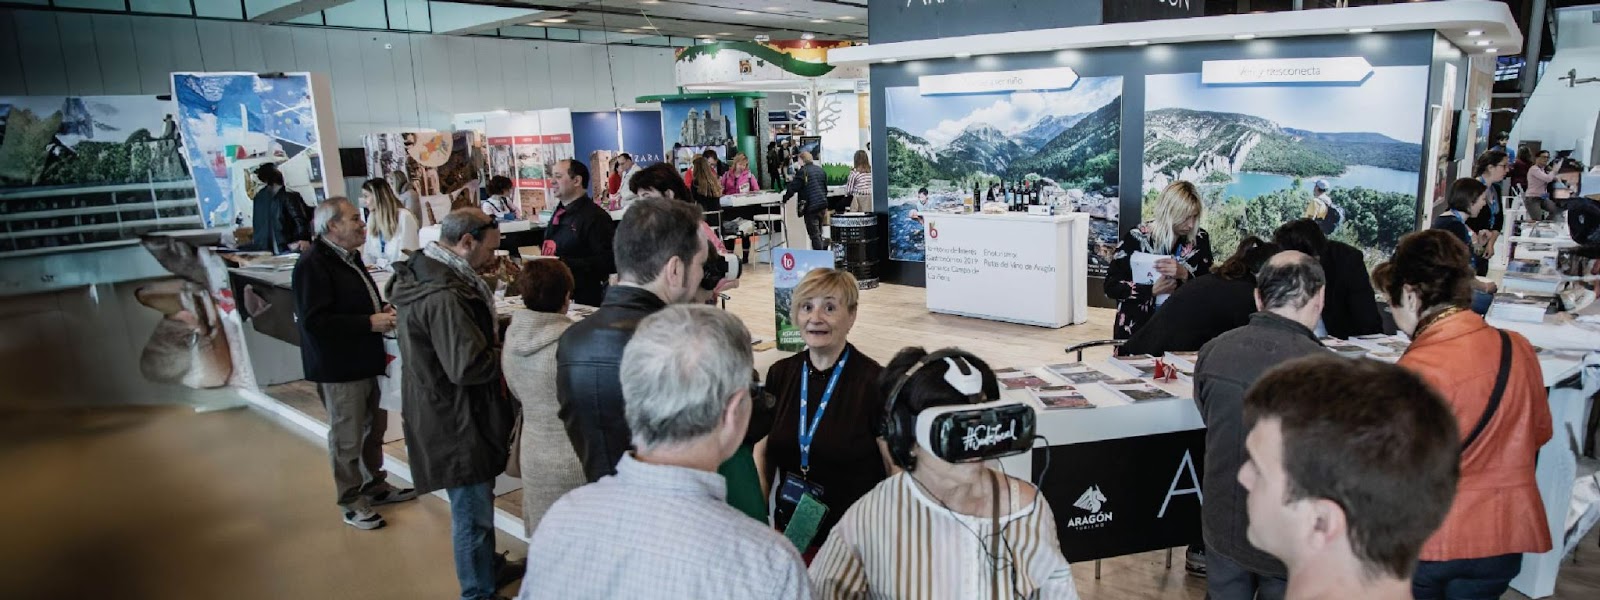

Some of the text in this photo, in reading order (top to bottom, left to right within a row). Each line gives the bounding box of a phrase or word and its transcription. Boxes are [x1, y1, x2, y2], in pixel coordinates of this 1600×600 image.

[1266, 66, 1321, 76] desconecta
[1007, 76, 1023, 85] niño
[964, 256, 979, 265] 2019
[1010, 261, 1024, 270] Vino
[1024, 263, 1032, 271] de
[1033, 263, 1056, 273] Aragón
[1067, 511, 1113, 528] ARAGÓN
